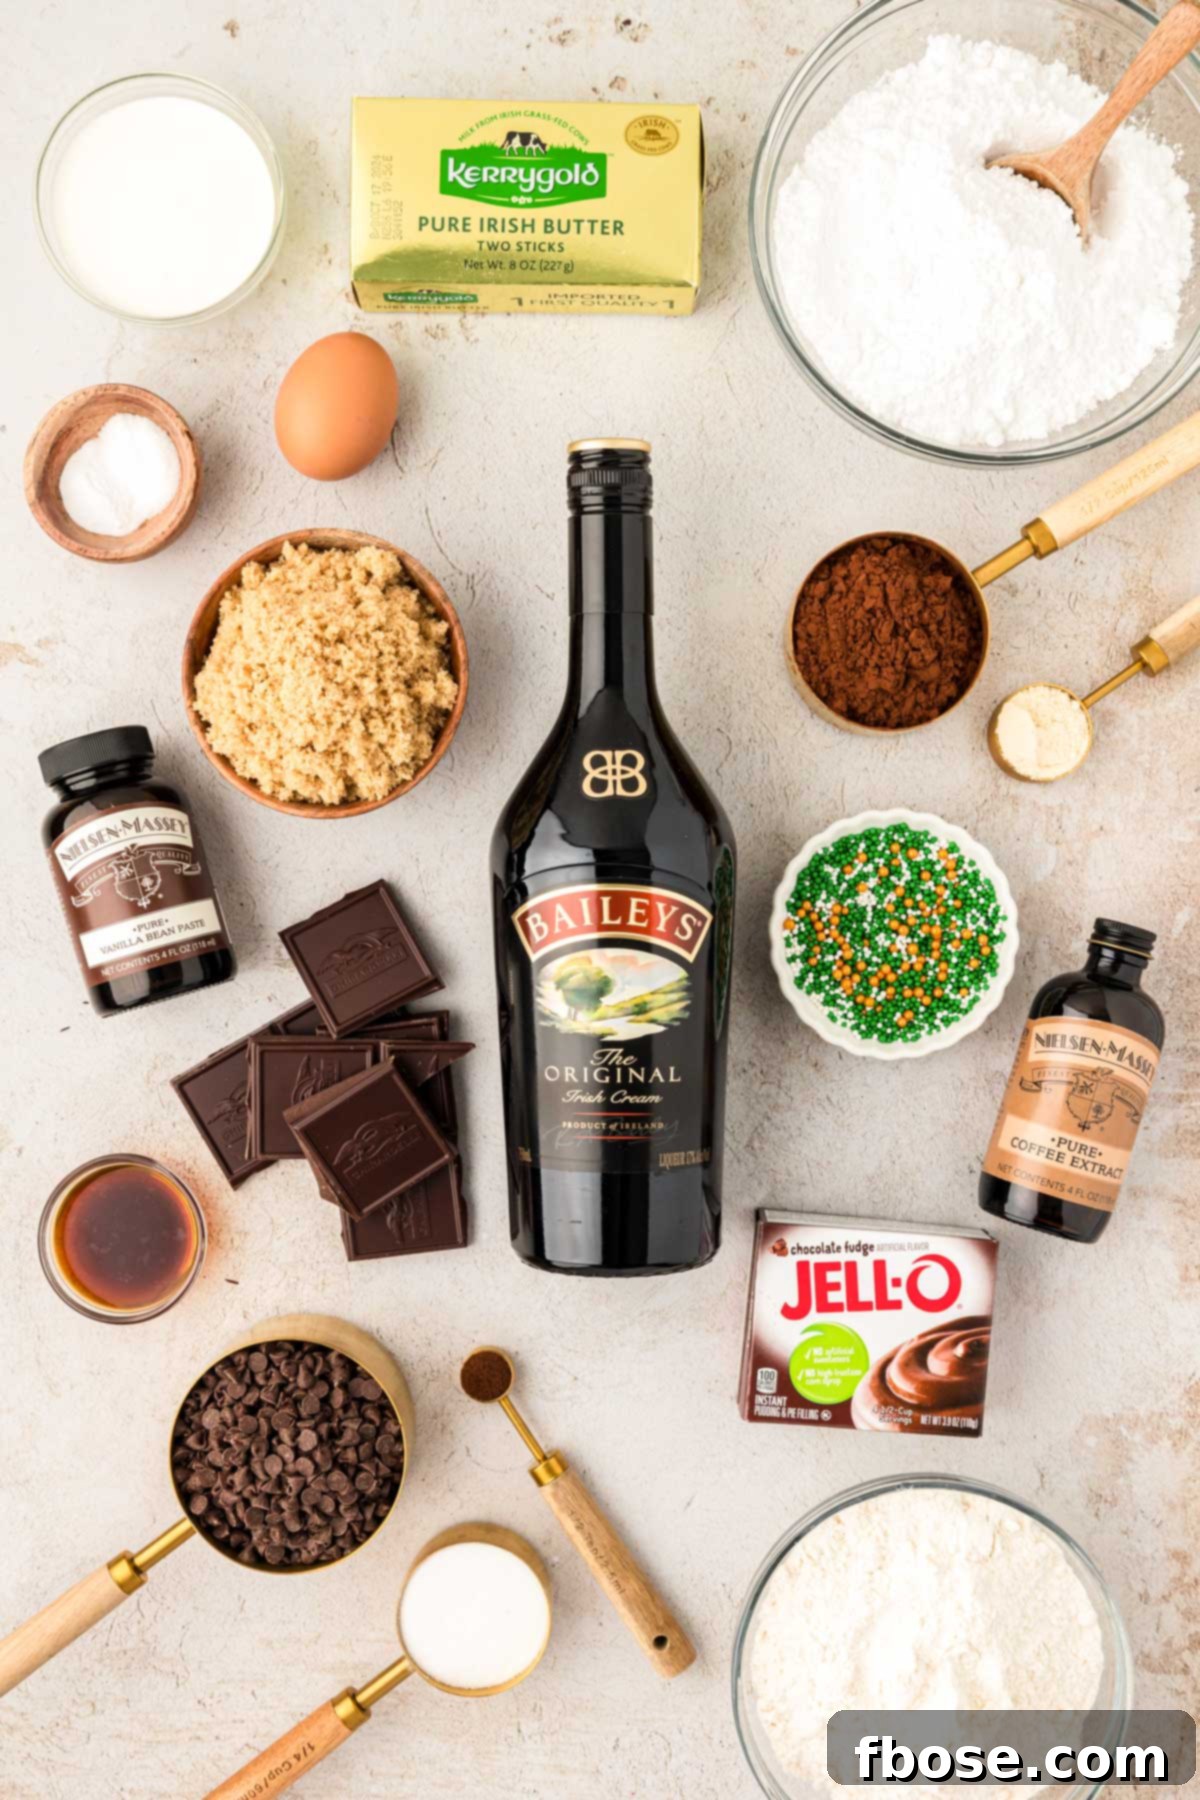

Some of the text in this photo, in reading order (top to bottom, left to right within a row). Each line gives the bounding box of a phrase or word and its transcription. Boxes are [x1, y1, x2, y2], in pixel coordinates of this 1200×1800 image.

[458, 126, 475, 142] MILK
[475, 114, 498, 129] FROM
[499, 110, 522, 120] IRISH
[569, 126, 590, 146] COWS
[418, 216, 625, 236] PURE IRISH BUTTER
[477, 240, 565, 254] TWO STICKS
[464, 258, 486, 271] Net
[488, 258, 505, 271] Wt.
[509, 259, 517, 271] 8
[520, 260, 537, 272] OZ
[547, 293, 641, 301] IMPORTED
[581, 299, 658, 307] QUALITY
[137, 918, 165, 933] PURE
[525, 895, 697, 945] BAILEYS
[99, 918, 206, 956] VANILLA BEAN PASTE
[115, 953, 161, 976] CONTENTS
[161, 950, 168, 961] 4
[168, 947, 179, 959] FL
[179, 944, 192, 957] OZ
[590, 1048, 637, 1067] The
[544, 1065, 681, 1084] ORIGINAL
[561, 1089, 664, 1104] Irish Cream
[562, 1121, 606, 1130] PRODUCT
[620, 1121, 664, 1130] IRELAND
[1057, 1136, 1098, 1159] PURE
[1010, 1136, 1124, 1180] COFFEE EXTRACT
[997, 1162, 1012, 1177] NET
[1012, 1166, 1066, 1193] CONTENTS
[1066, 1185, 1074, 1195] 4
[1075, 1187, 1087, 1200] FL
[1086, 1190, 1101, 1203] OZ
[791, 1241, 842, 1255] chocolate
[844, 1240, 874, 1257] fudge
[780, 1253, 962, 1320] JELL-O
[760, 1370, 775, 1381] 100
[755, 1394, 787, 1407] INSTANT
[293, 1741, 316, 1763] 1/4
